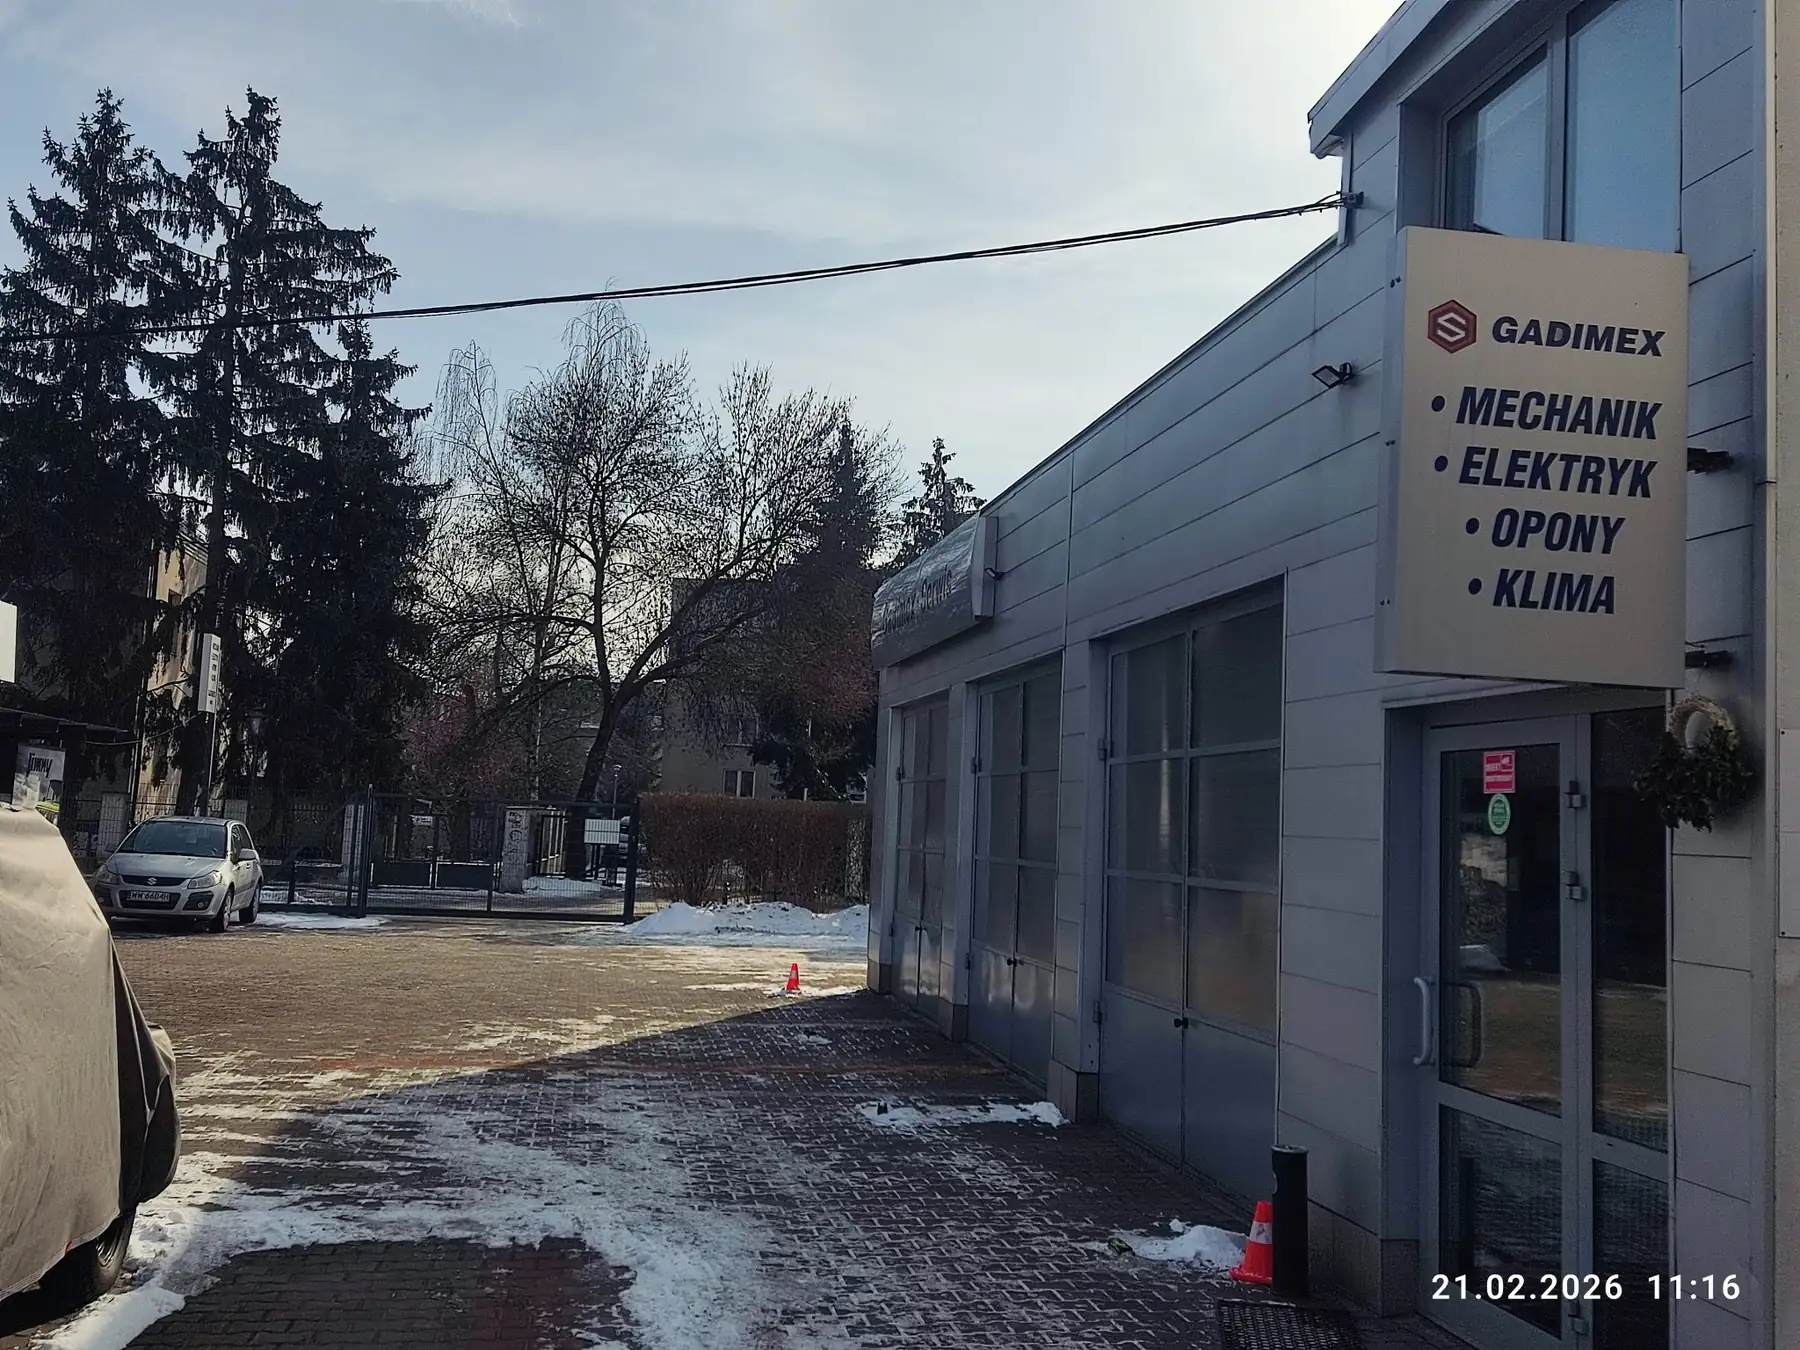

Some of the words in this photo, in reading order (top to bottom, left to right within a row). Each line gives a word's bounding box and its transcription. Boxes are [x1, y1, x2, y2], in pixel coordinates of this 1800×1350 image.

[1492, 316, 1665, 357] GADIMEX
[1456, 386, 1663, 440] MECHANIK
[1458, 446, 1659, 499] ELEKTRYK
[1491, 508, 1626, 555] OPONY
[1492, 568, 1616, 615] KLIMA
